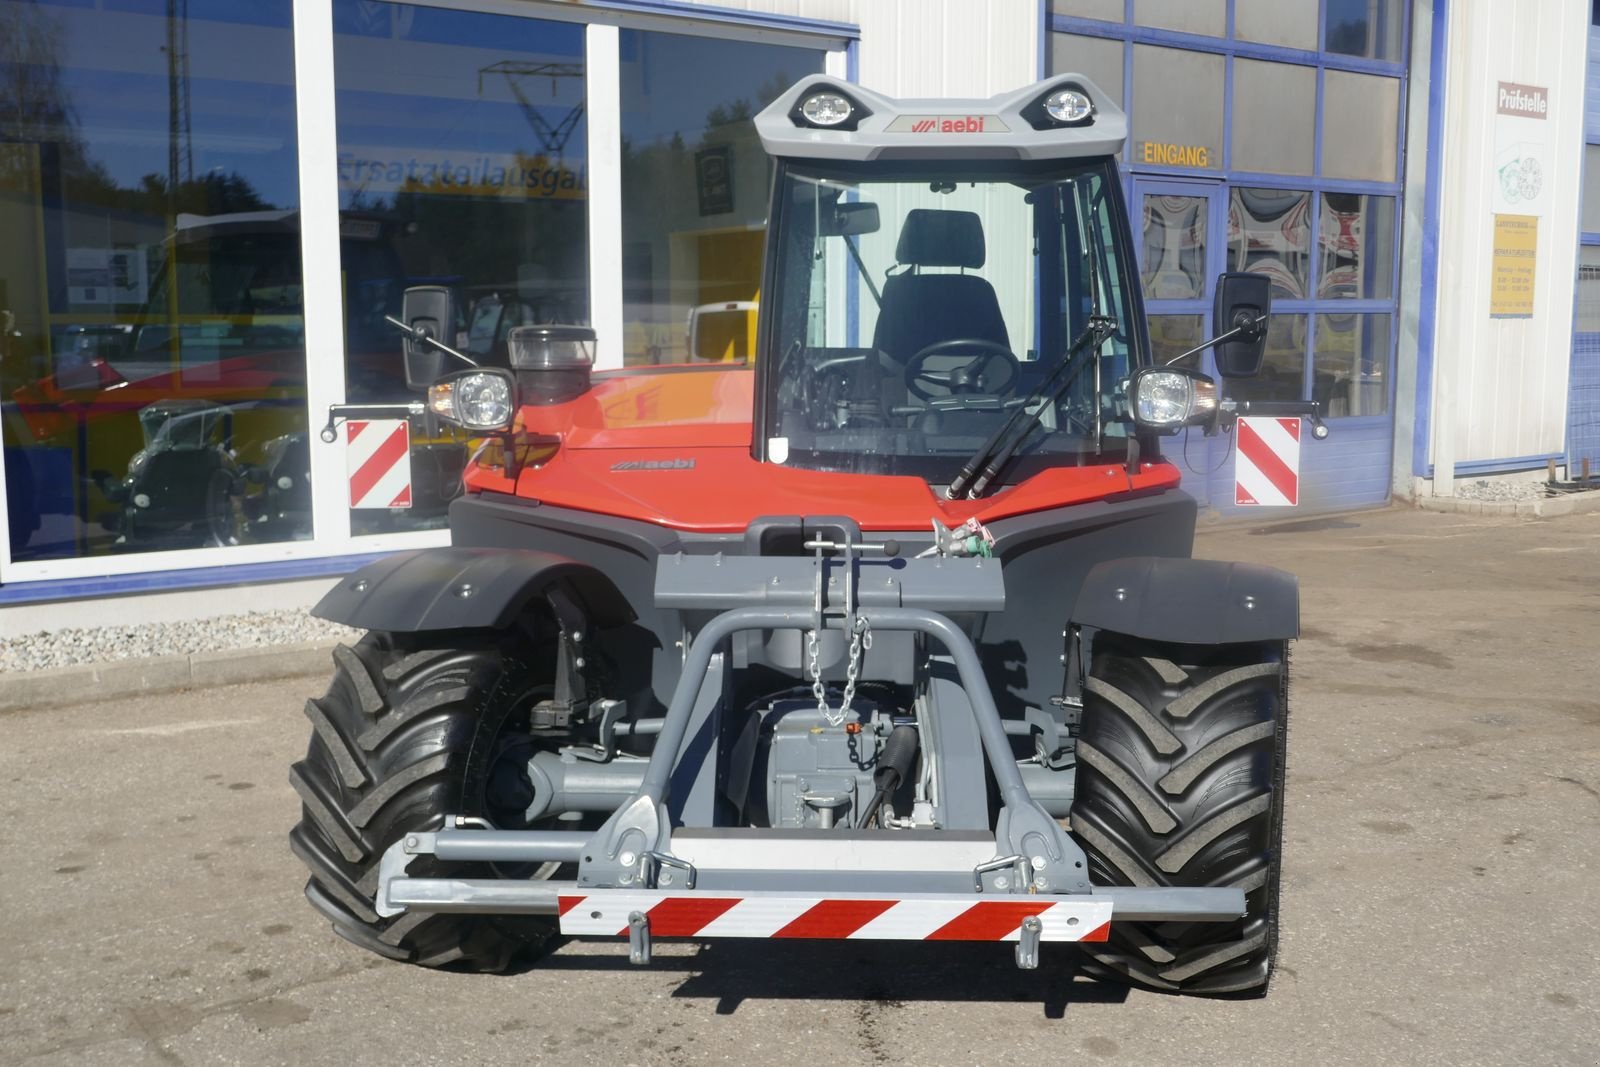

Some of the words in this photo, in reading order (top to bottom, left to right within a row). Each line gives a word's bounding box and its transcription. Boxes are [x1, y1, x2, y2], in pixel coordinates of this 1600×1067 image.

[1499, 87, 1547, 113] Prüfstelle
[941, 115, 984, 133] aebi
[1144, 142, 1208, 167] EINGANG
[645, 457, 696, 470] aebi
